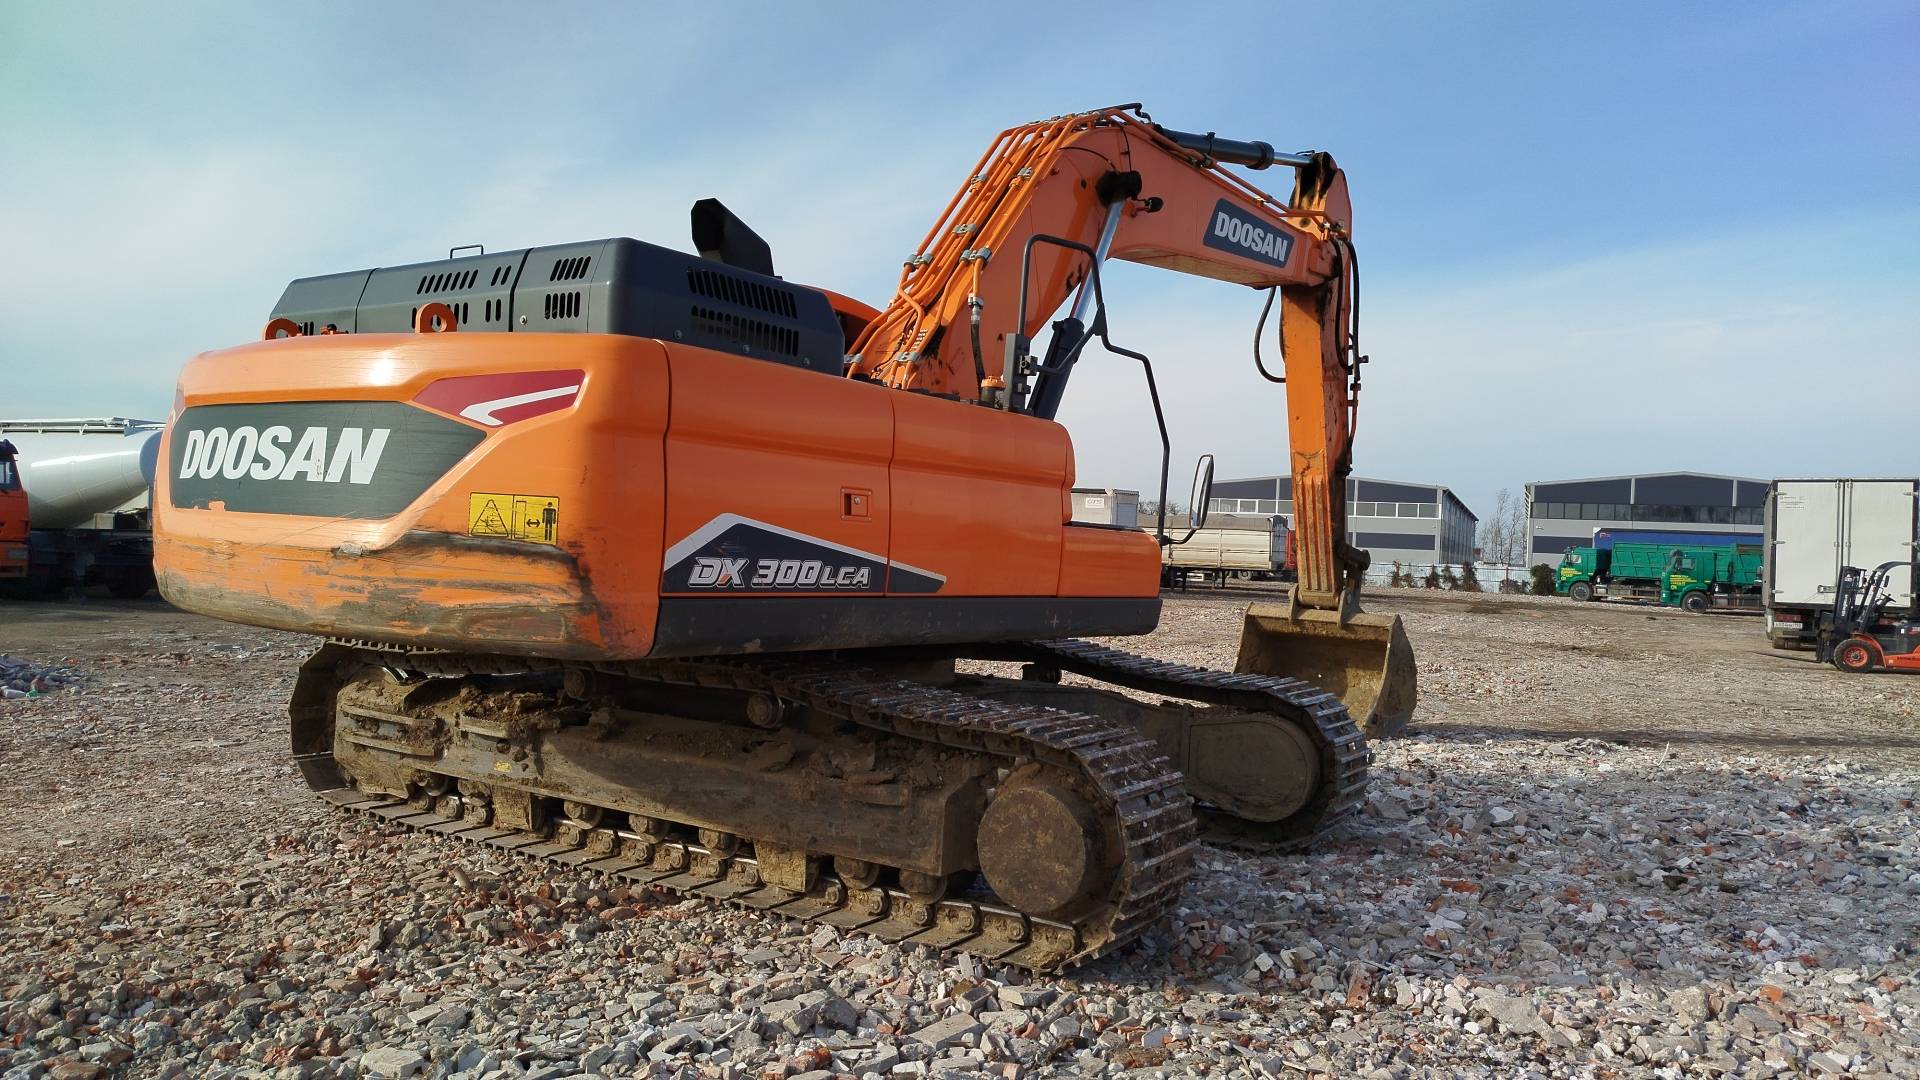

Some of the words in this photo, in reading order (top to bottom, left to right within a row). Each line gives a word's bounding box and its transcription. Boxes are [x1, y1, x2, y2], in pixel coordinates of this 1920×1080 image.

[1214, 211, 1288, 262] DOOSAN
[179, 425, 391, 485] DOOSAN
[688, 557, 749, 588] DX
[751, 559, 871, 588] 300LCA
